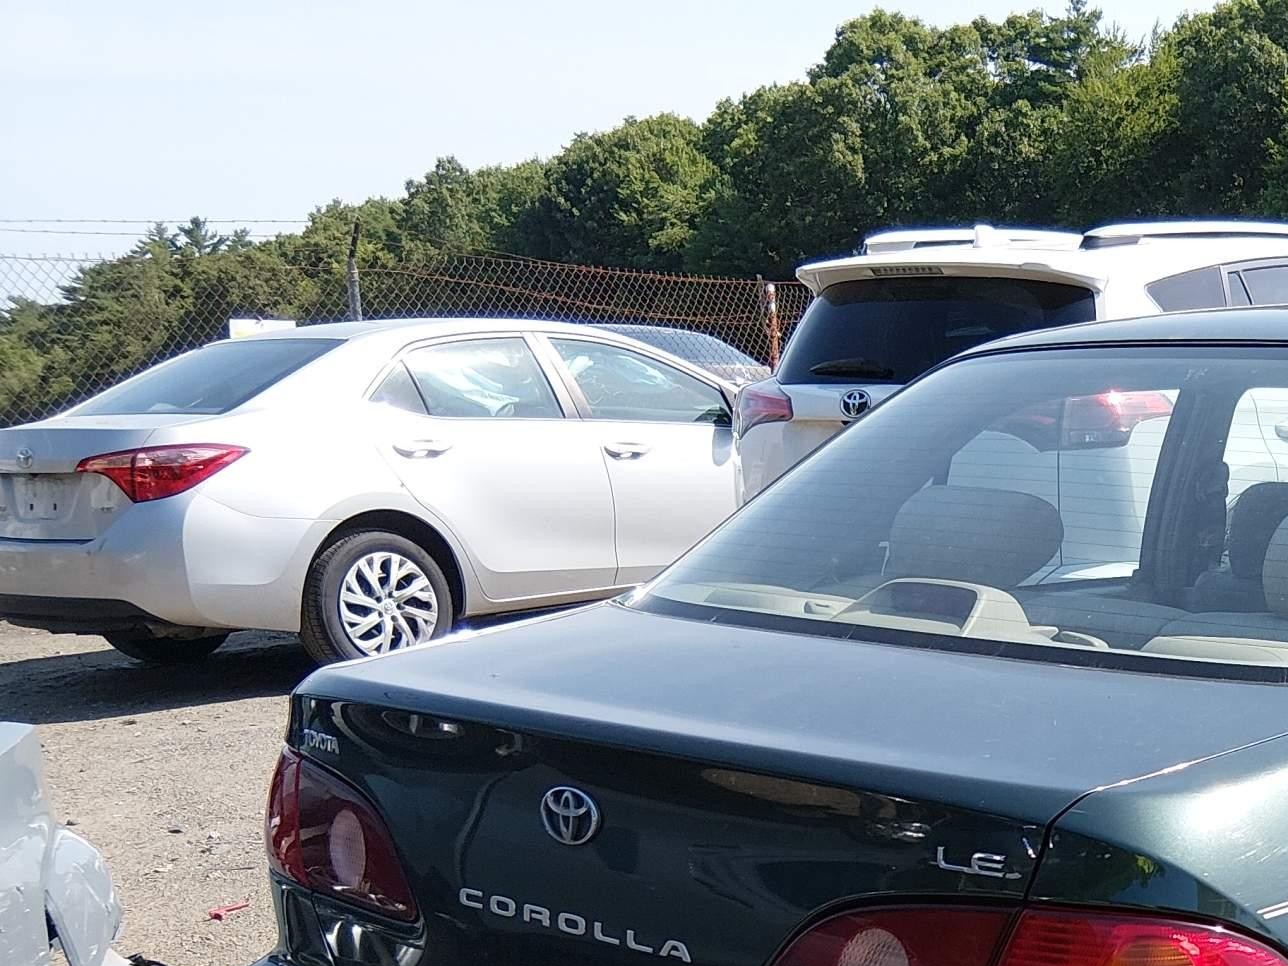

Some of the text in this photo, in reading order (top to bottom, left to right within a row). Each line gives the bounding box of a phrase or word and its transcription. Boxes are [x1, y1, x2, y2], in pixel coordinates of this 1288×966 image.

[303, 728, 340, 755] TOYOTA
[935, 846, 1008, 879] LE
[459, 887, 693, 964] COROLLA
